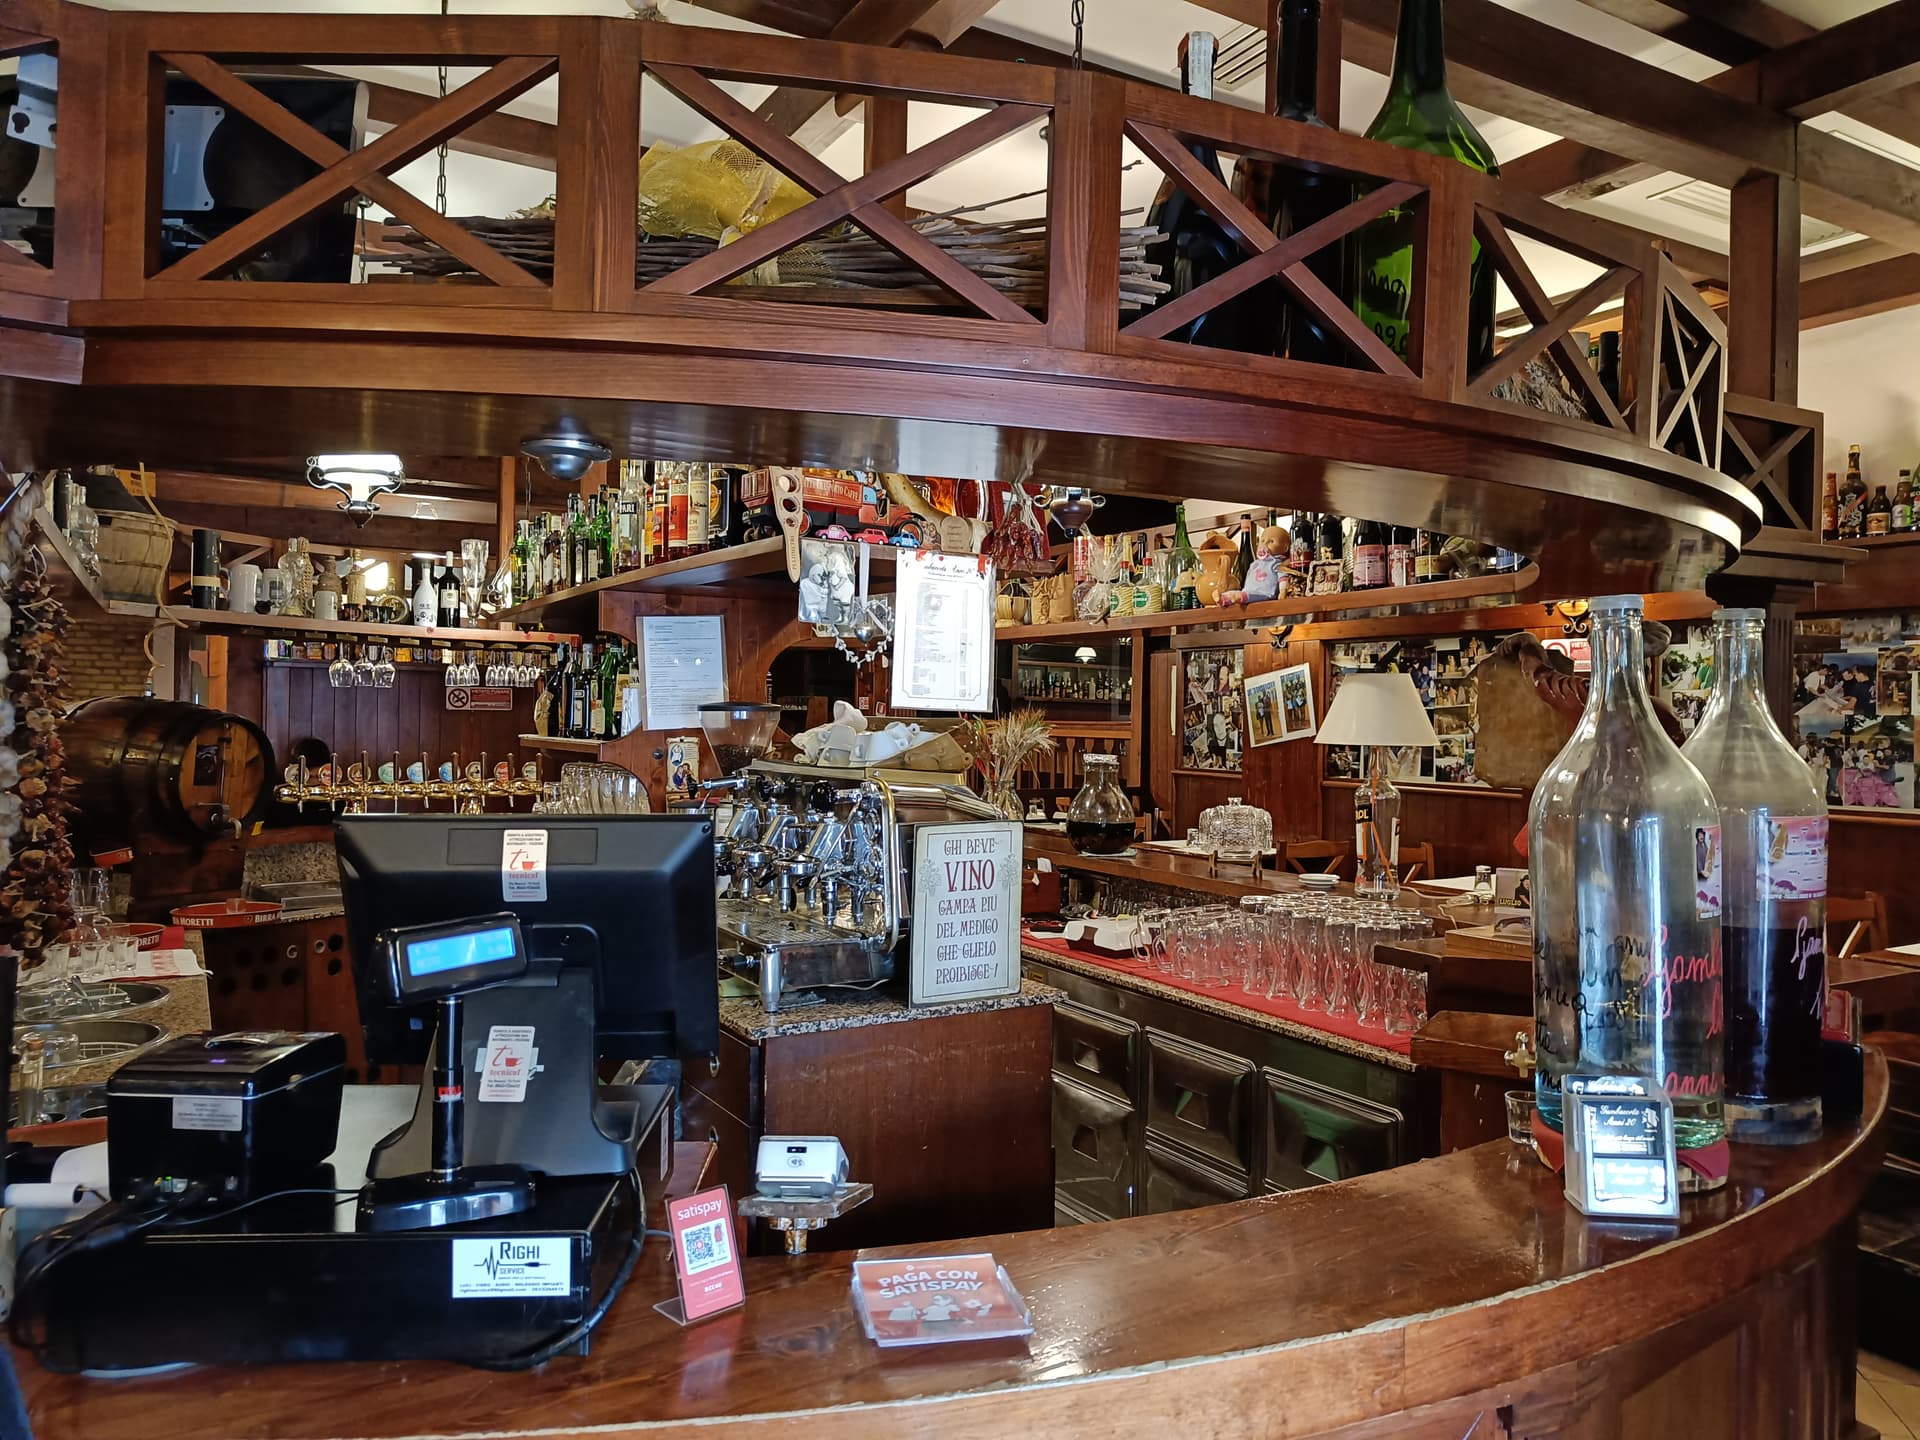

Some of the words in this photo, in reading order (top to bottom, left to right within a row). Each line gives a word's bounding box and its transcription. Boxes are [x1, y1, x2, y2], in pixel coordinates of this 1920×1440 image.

[966, 837, 997, 855] BEVE
[944, 858, 995, 893] VINO
[180, 917, 214, 926] MORETTI
[254, 913, 278, 924] BIRRA
[936, 922, 957, 939] DEL
[962, 940, 997, 959] GLIELO
[677, 1199, 722, 1220] satispay
[878, 1271, 932, 1288] PAGA
[935, 1270, 978, 1280] CON
[879, 1280, 984, 1299] SATISPAY
